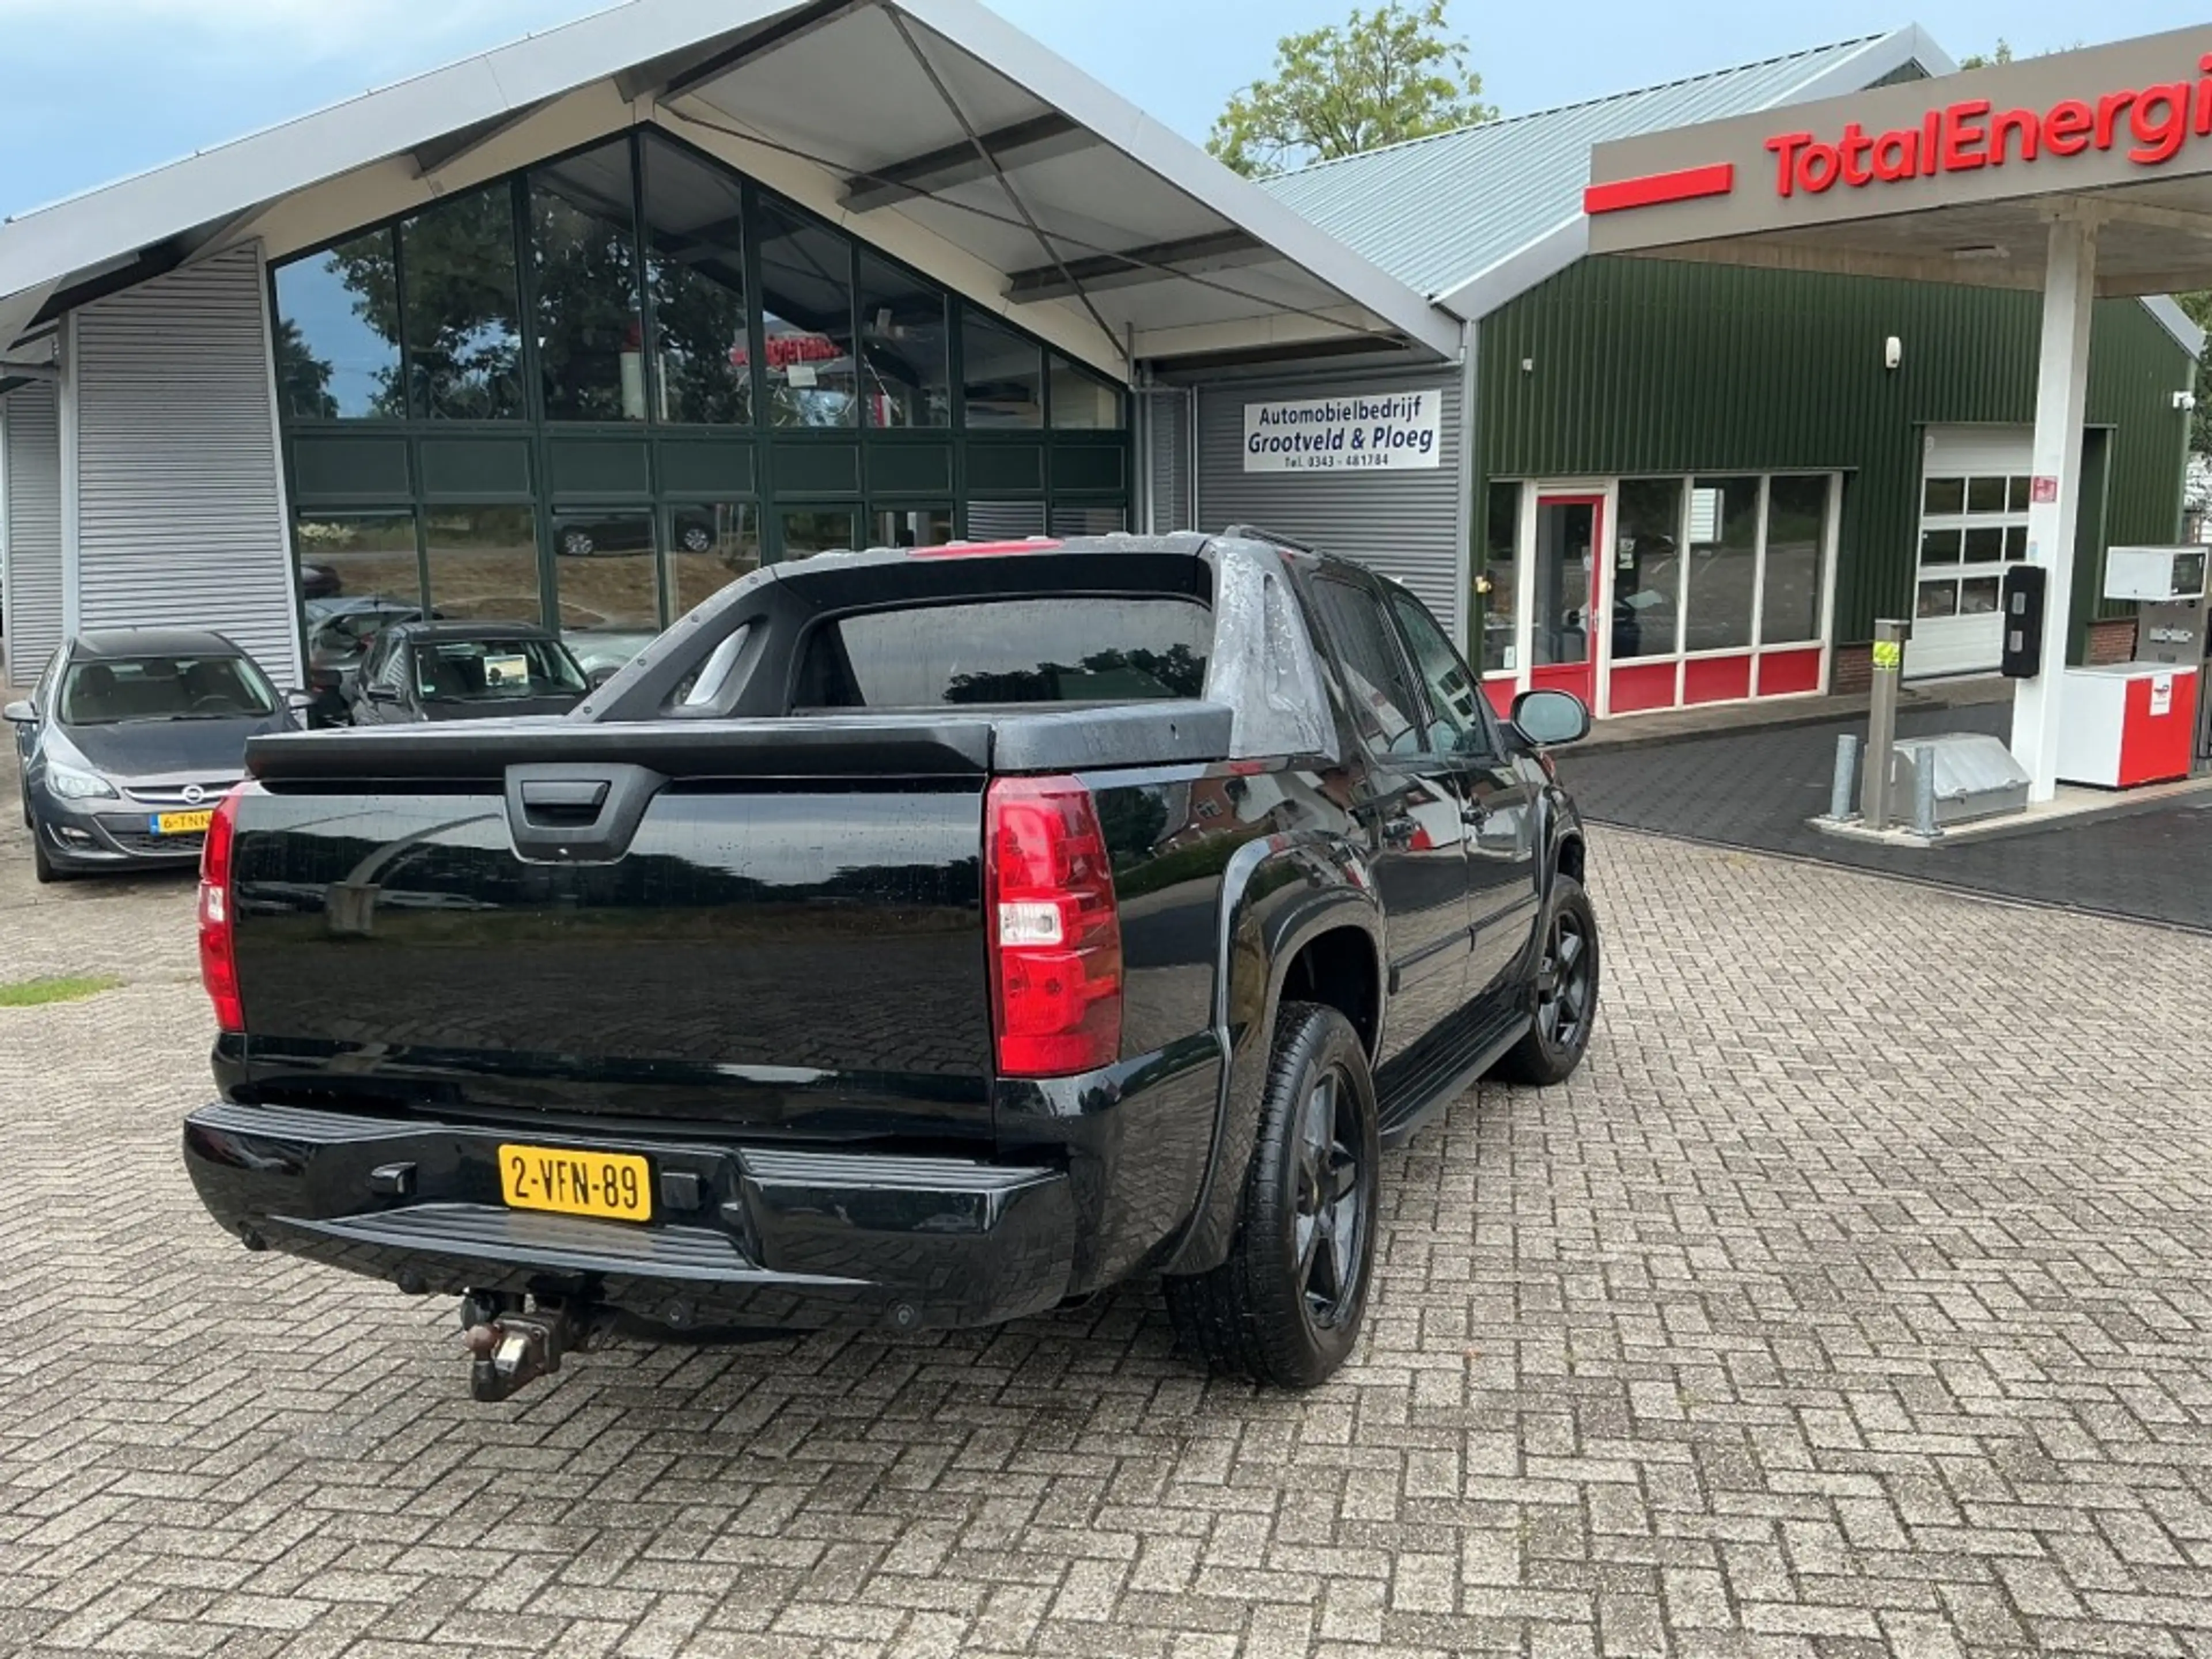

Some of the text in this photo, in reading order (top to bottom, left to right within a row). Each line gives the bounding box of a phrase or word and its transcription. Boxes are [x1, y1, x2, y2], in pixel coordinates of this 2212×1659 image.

[1766, 53, 2212, 196] TotalEnergi
[1259, 395, 1422, 426] Automobielbedrijf
[1249, 424, 1433, 453] Grootveld & Ploeg
[1308, 455, 1334, 467] 0343
[512, 1156, 638, 1209] 2-VFN-89
